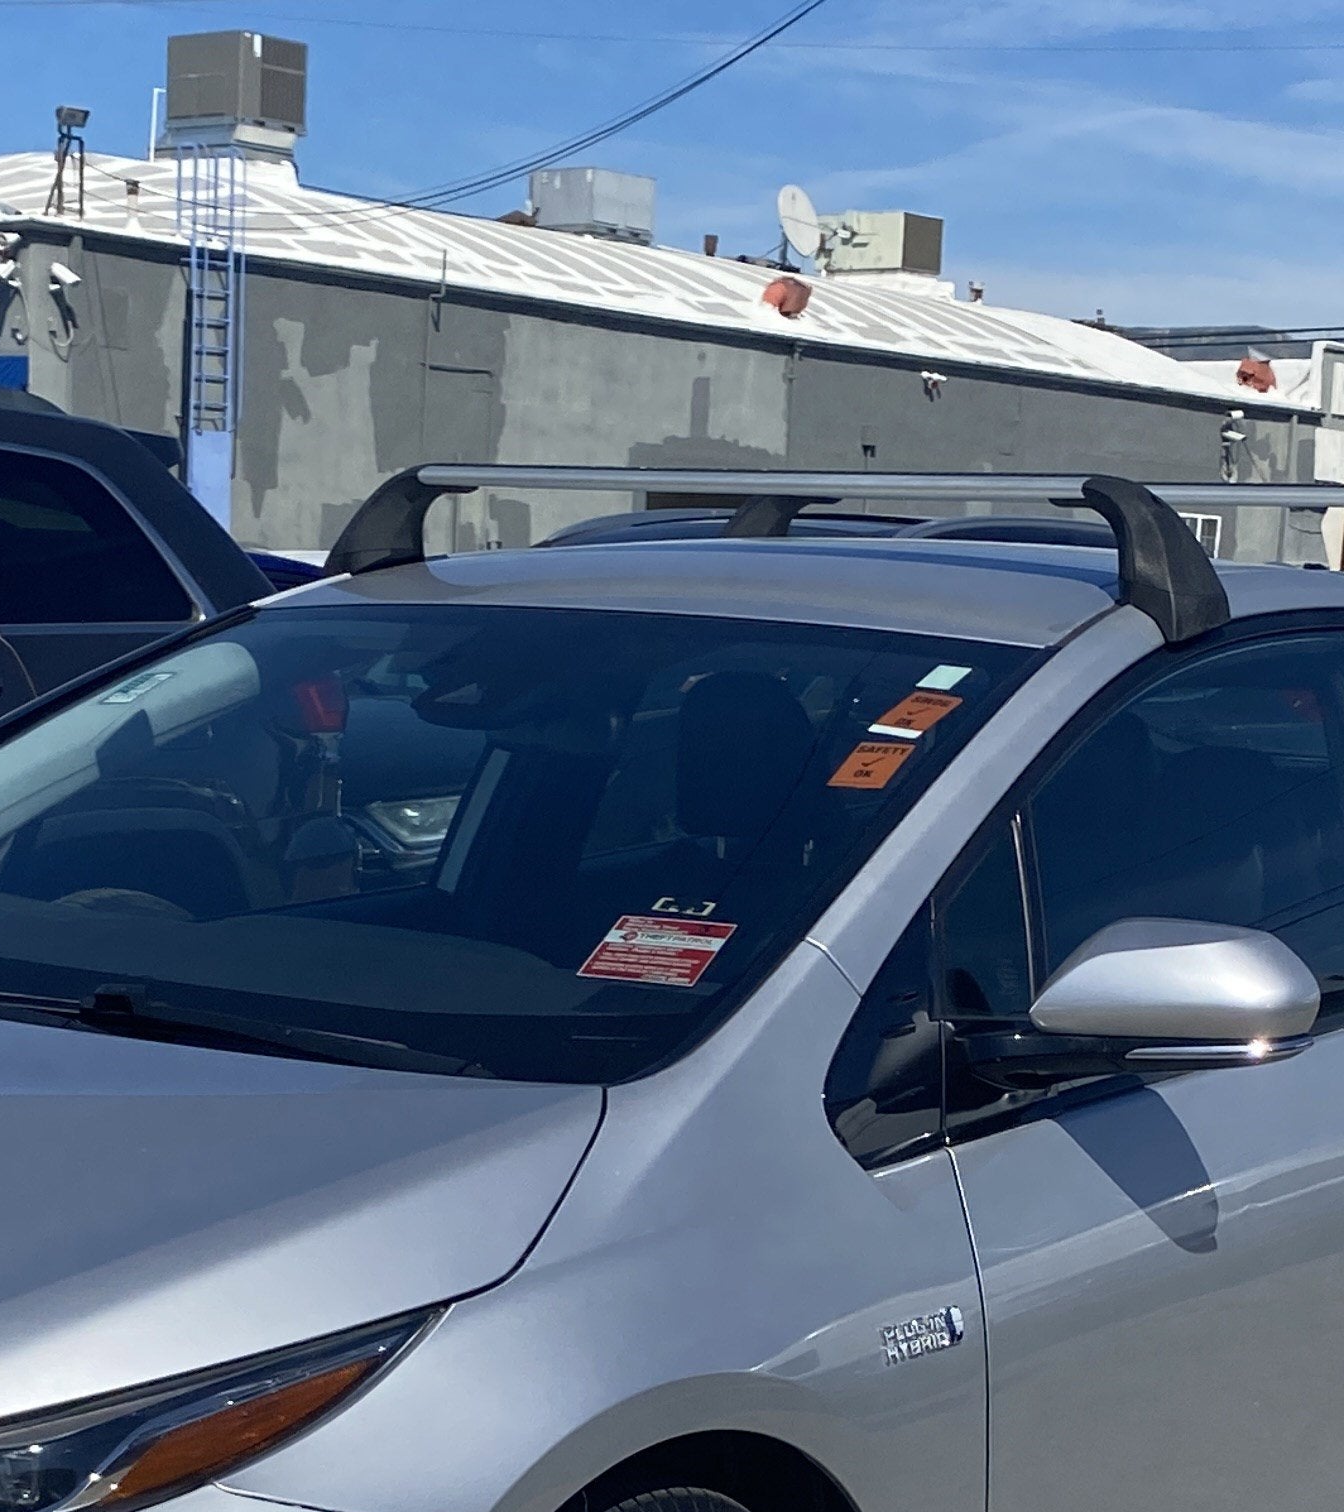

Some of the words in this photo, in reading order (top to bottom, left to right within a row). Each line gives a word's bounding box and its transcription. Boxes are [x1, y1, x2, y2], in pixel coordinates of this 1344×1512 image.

[857, 745, 906, 755] SAFETY
[853, 770, 874, 778] OK
[885, 1332, 951, 1363] HYBRID
